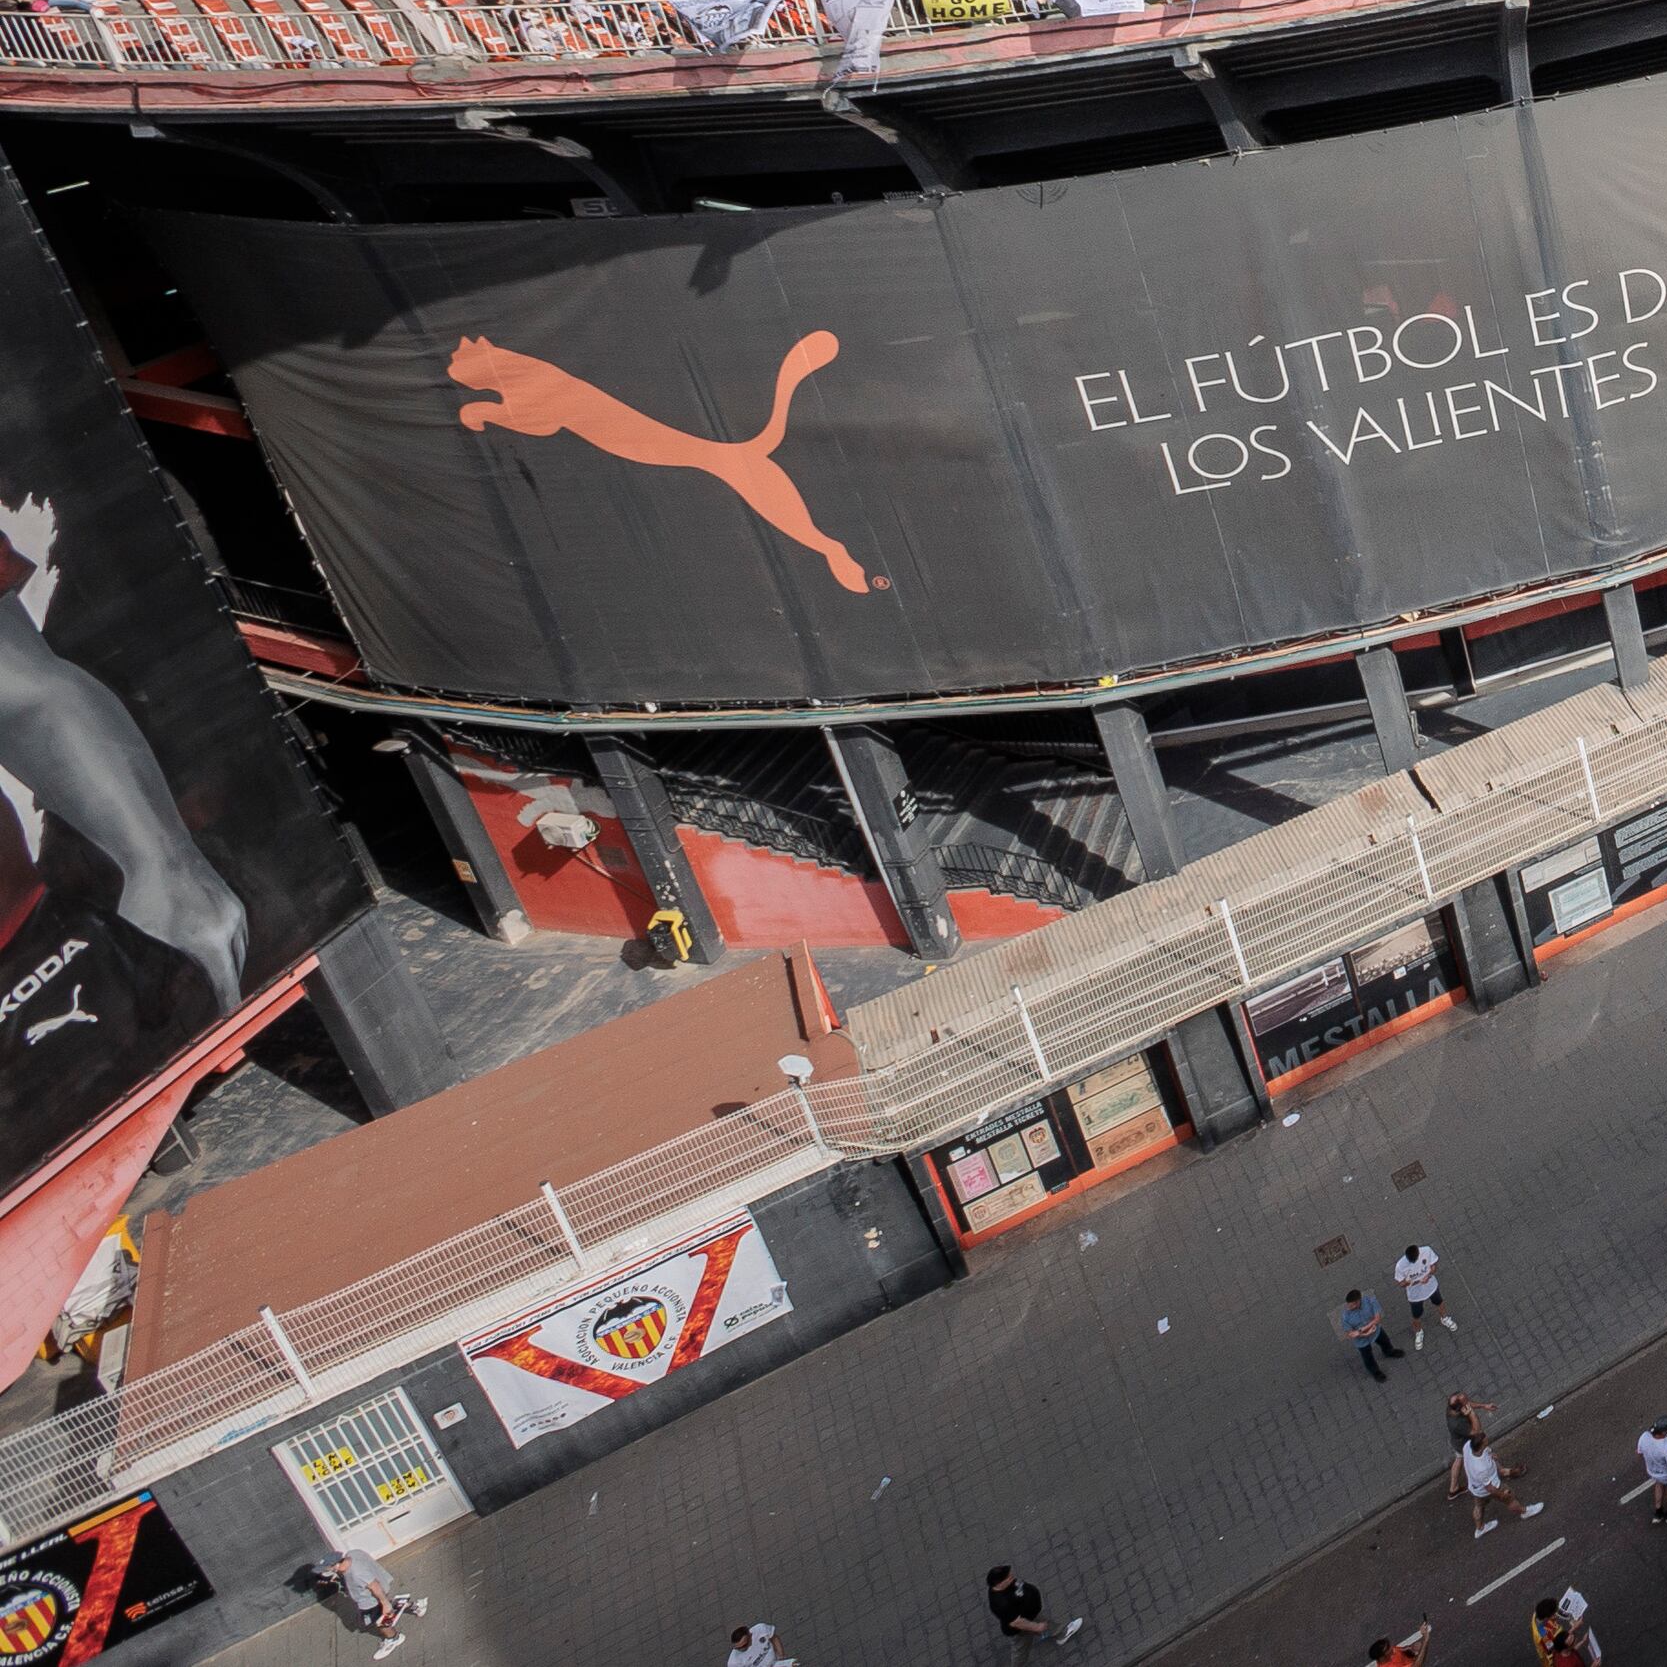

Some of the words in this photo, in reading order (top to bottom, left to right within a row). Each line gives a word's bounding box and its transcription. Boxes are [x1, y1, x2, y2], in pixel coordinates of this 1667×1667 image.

[931, 2, 1008, 21] HOME
[1073, 369, 1172, 432] EL
[1184, 303, 1509, 413] FÚTBOL
[1524, 279, 1599, 348] ES
[1160, 424, 1292, 495] LOS
[1306, 342, 1659, 466] VALIENTES
[1267, 976, 1447, 1079] MESTALLA
[964, 1116, 1005, 1143] ENTRADES
[1004, 1100, 1043, 1123] MESTALLA
[974, 1120, 1015, 1145] MESTALLA
[1013, 1107, 1045, 1128] TICKETS
[589, 1283, 650, 1316] PEQUEÑO
[649, 1284, 688, 1324] ACCIONISTA
[611, 1349, 665, 1372] VALENCIA
[20, 1532, 68, 1560] LLEAL
[31, 1570, 82, 1612] ACCIONISTA
